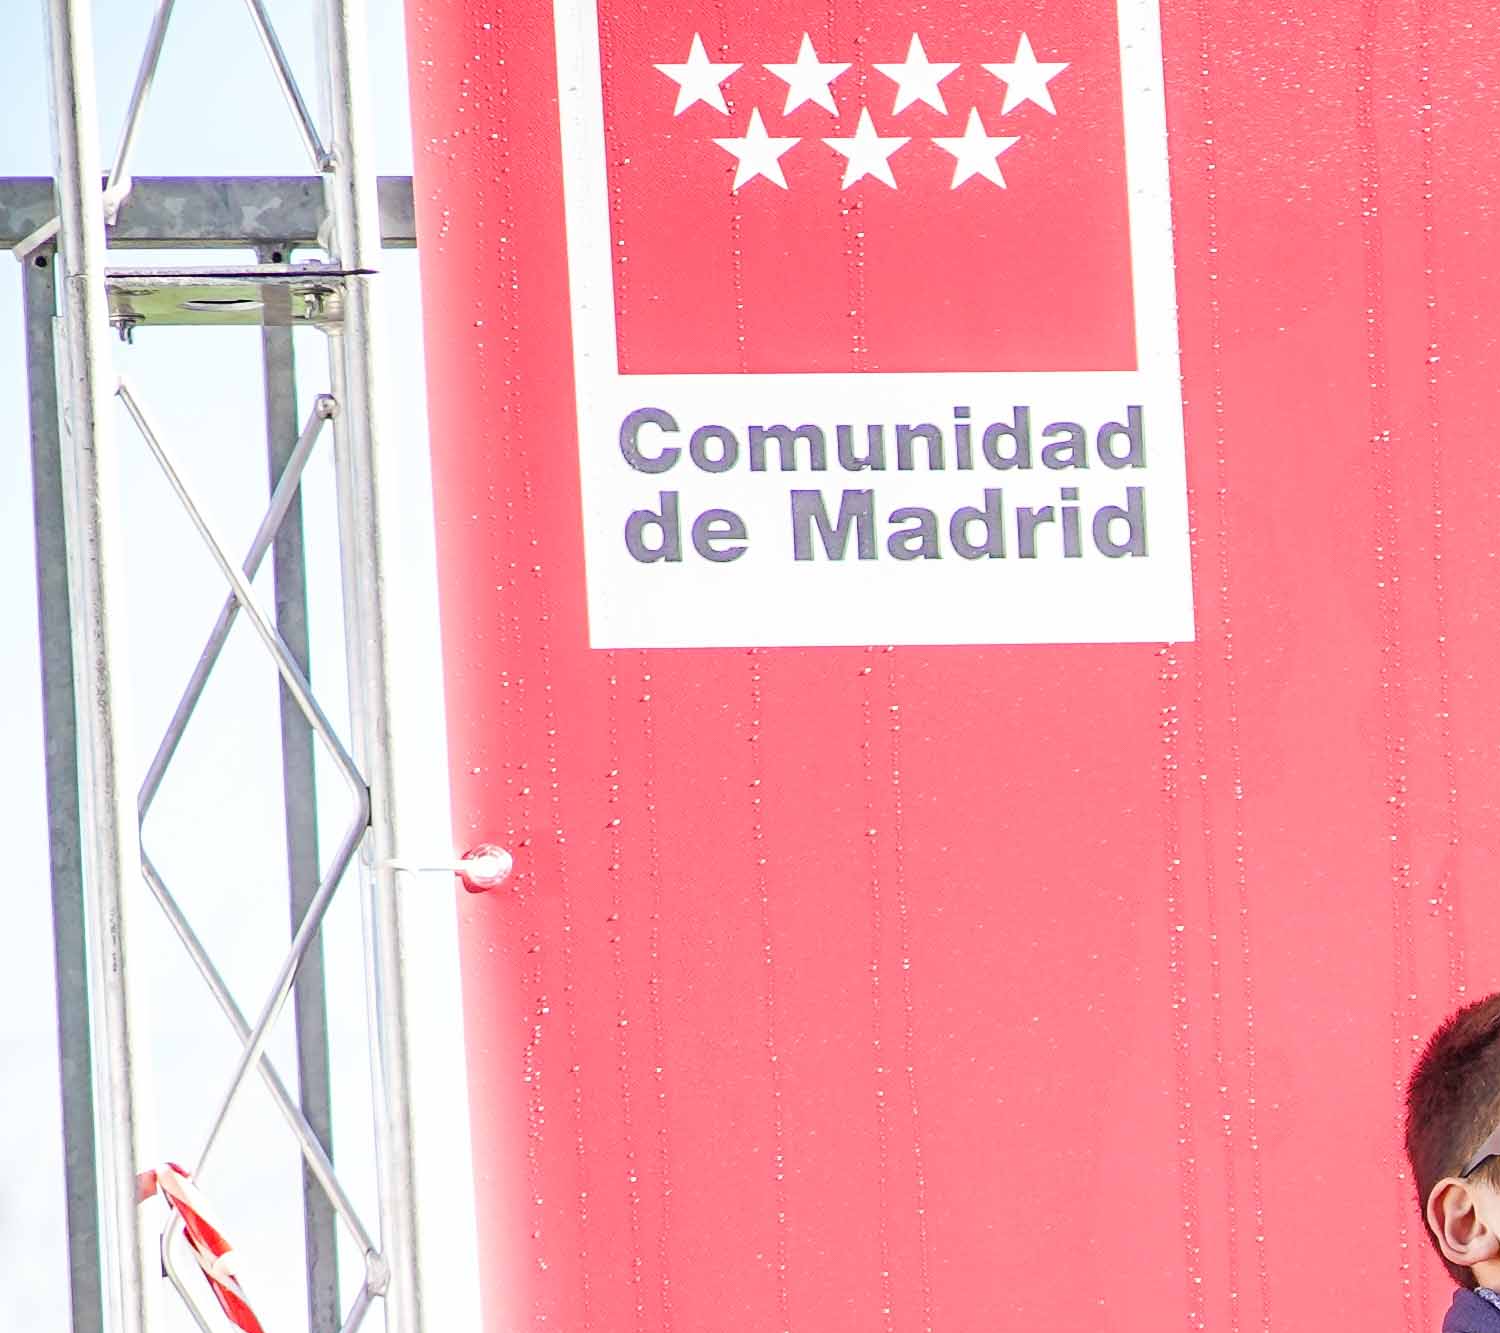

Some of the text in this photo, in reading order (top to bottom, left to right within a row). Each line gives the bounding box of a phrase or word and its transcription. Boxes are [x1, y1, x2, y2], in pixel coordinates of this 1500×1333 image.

[619, 406, 1148, 474] Comunidad
[625, 487, 1149, 562] de Madrid
